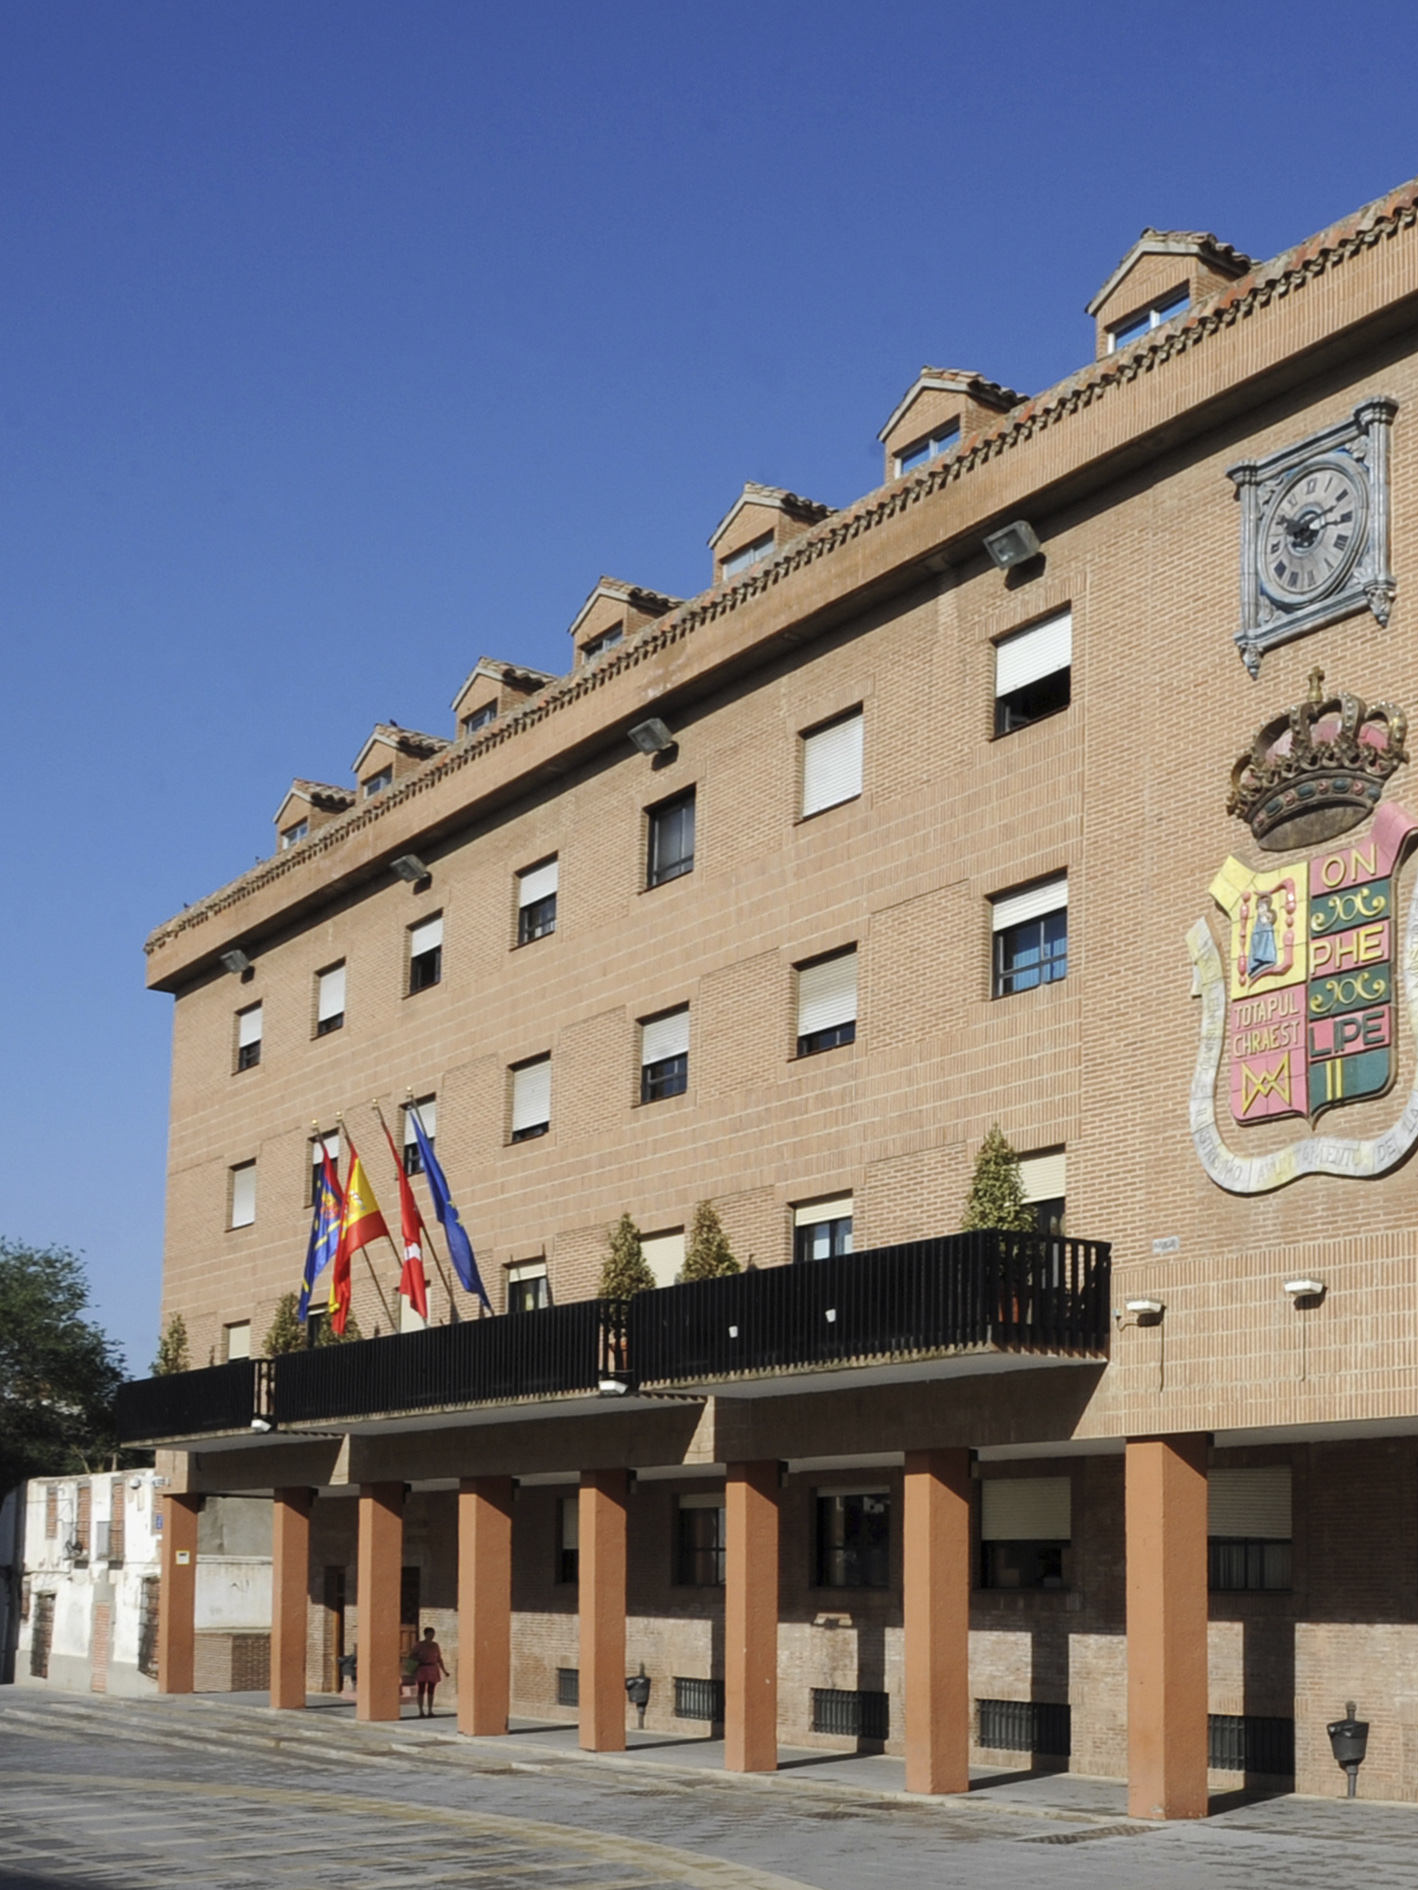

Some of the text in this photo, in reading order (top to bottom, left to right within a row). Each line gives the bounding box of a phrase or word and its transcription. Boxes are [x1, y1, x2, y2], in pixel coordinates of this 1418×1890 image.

[1321, 842, 1377, 888] ON
[1310, 924, 1383, 976] PHE
[1309, 1010, 1386, 1057] LIPE
